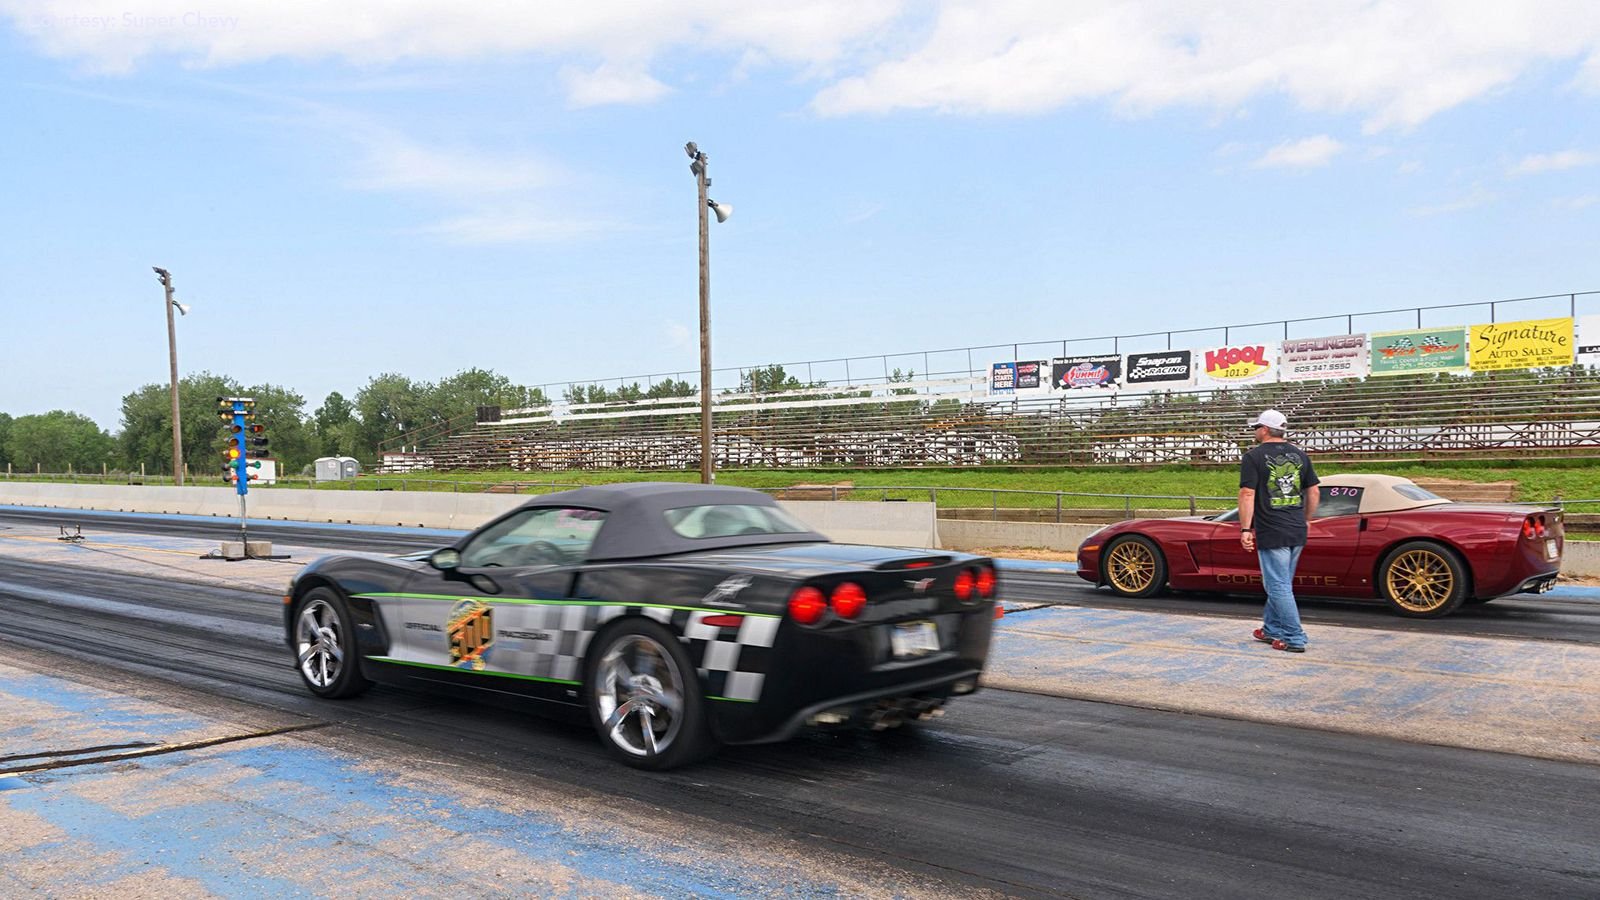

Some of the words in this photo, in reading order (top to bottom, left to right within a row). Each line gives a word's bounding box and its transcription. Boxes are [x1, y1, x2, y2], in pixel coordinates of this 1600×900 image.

[1475, 324, 1567, 353] Signature
[1488, 350, 1519, 359] AUTO
[1521, 347, 1553, 357] SALES
[1136, 357, 1182, 367] Snap-on
[1205, 345, 1269, 373] KOOL
[1148, 366, 1188, 376] RACING
[1223, 368, 1249, 378] 101.9
[1329, 486, 1358, 497] 870
[1216, 573, 1338, 586] CORTTE
